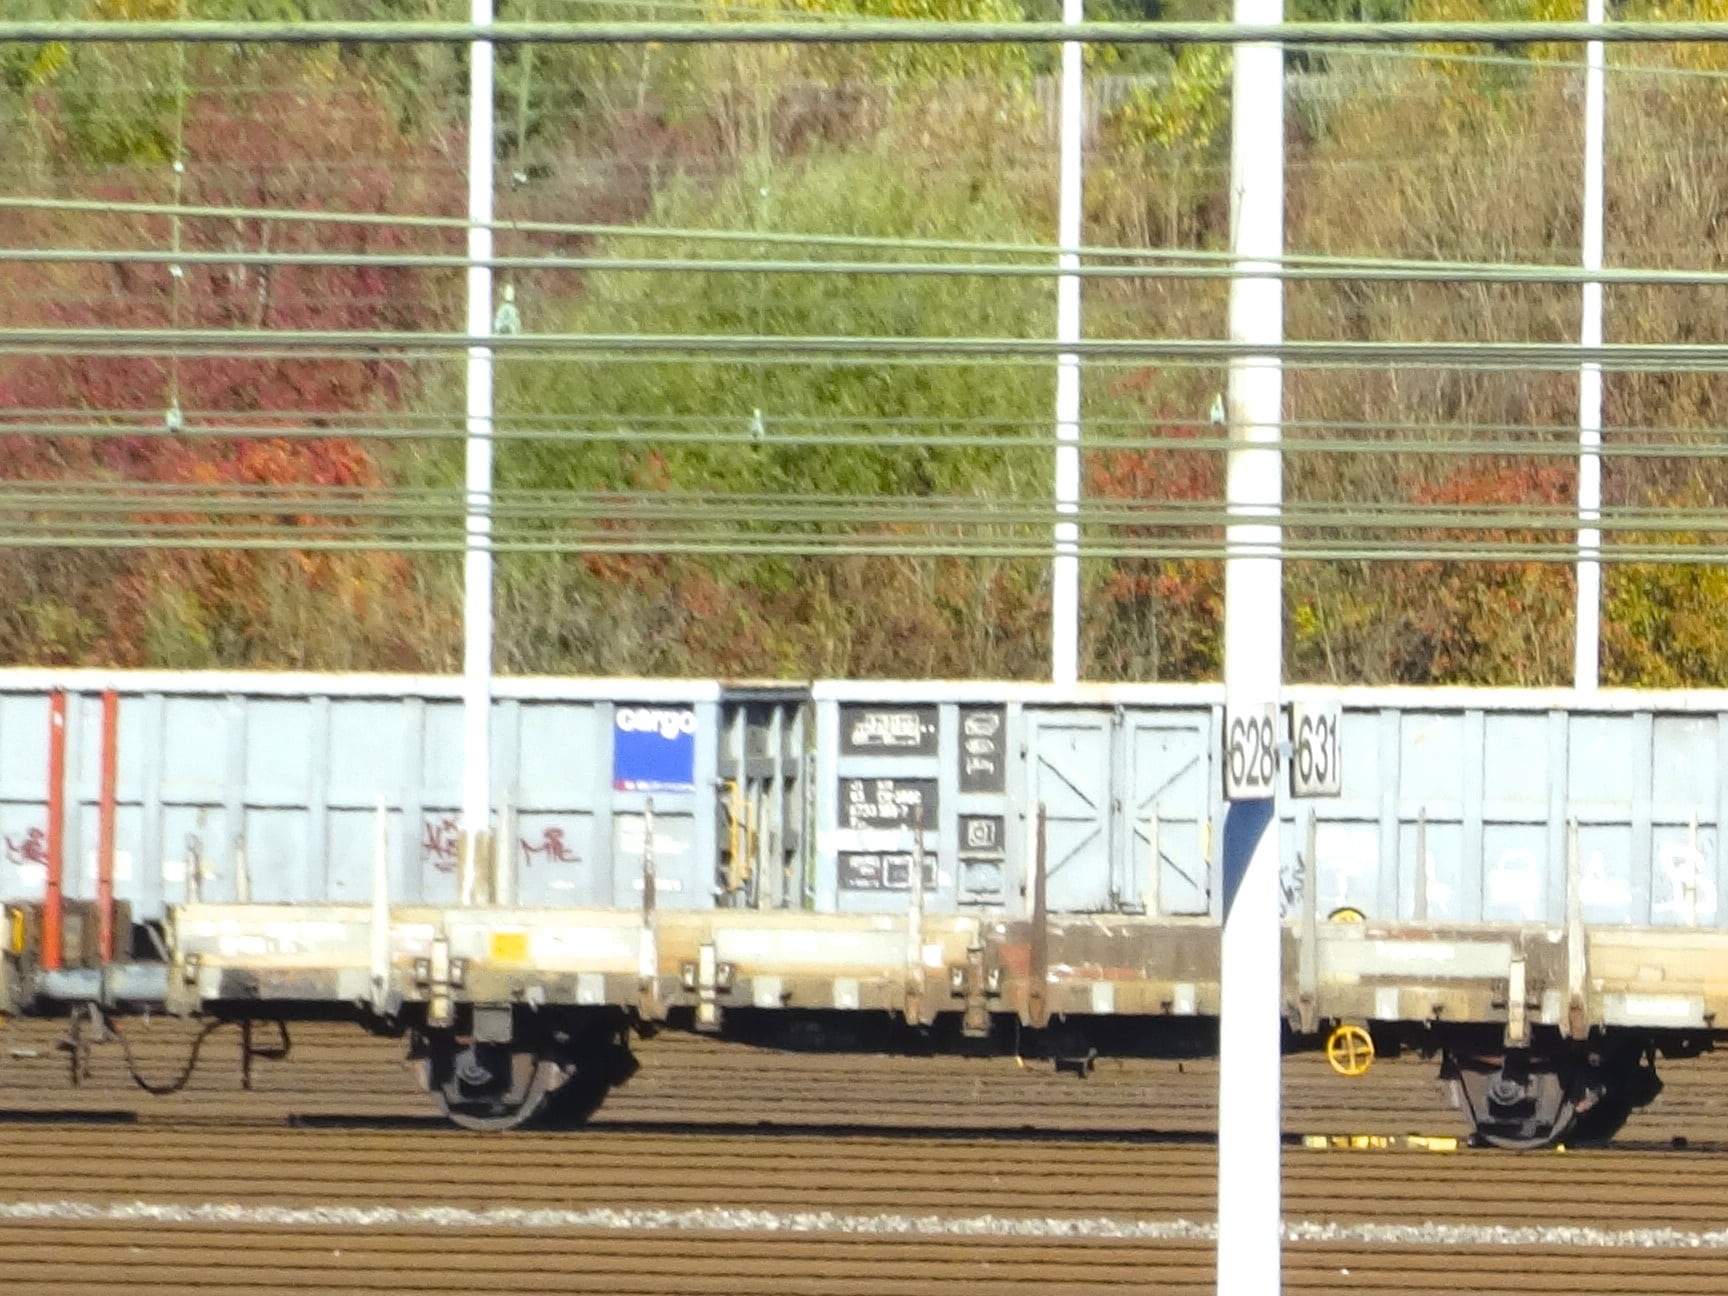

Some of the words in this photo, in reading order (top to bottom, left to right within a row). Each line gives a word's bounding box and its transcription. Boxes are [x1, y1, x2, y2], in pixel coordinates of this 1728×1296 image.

[616, 708, 697, 740] cargo
[1230, 715, 1274, 787] 628
[1299, 713, 1337, 785] 631
